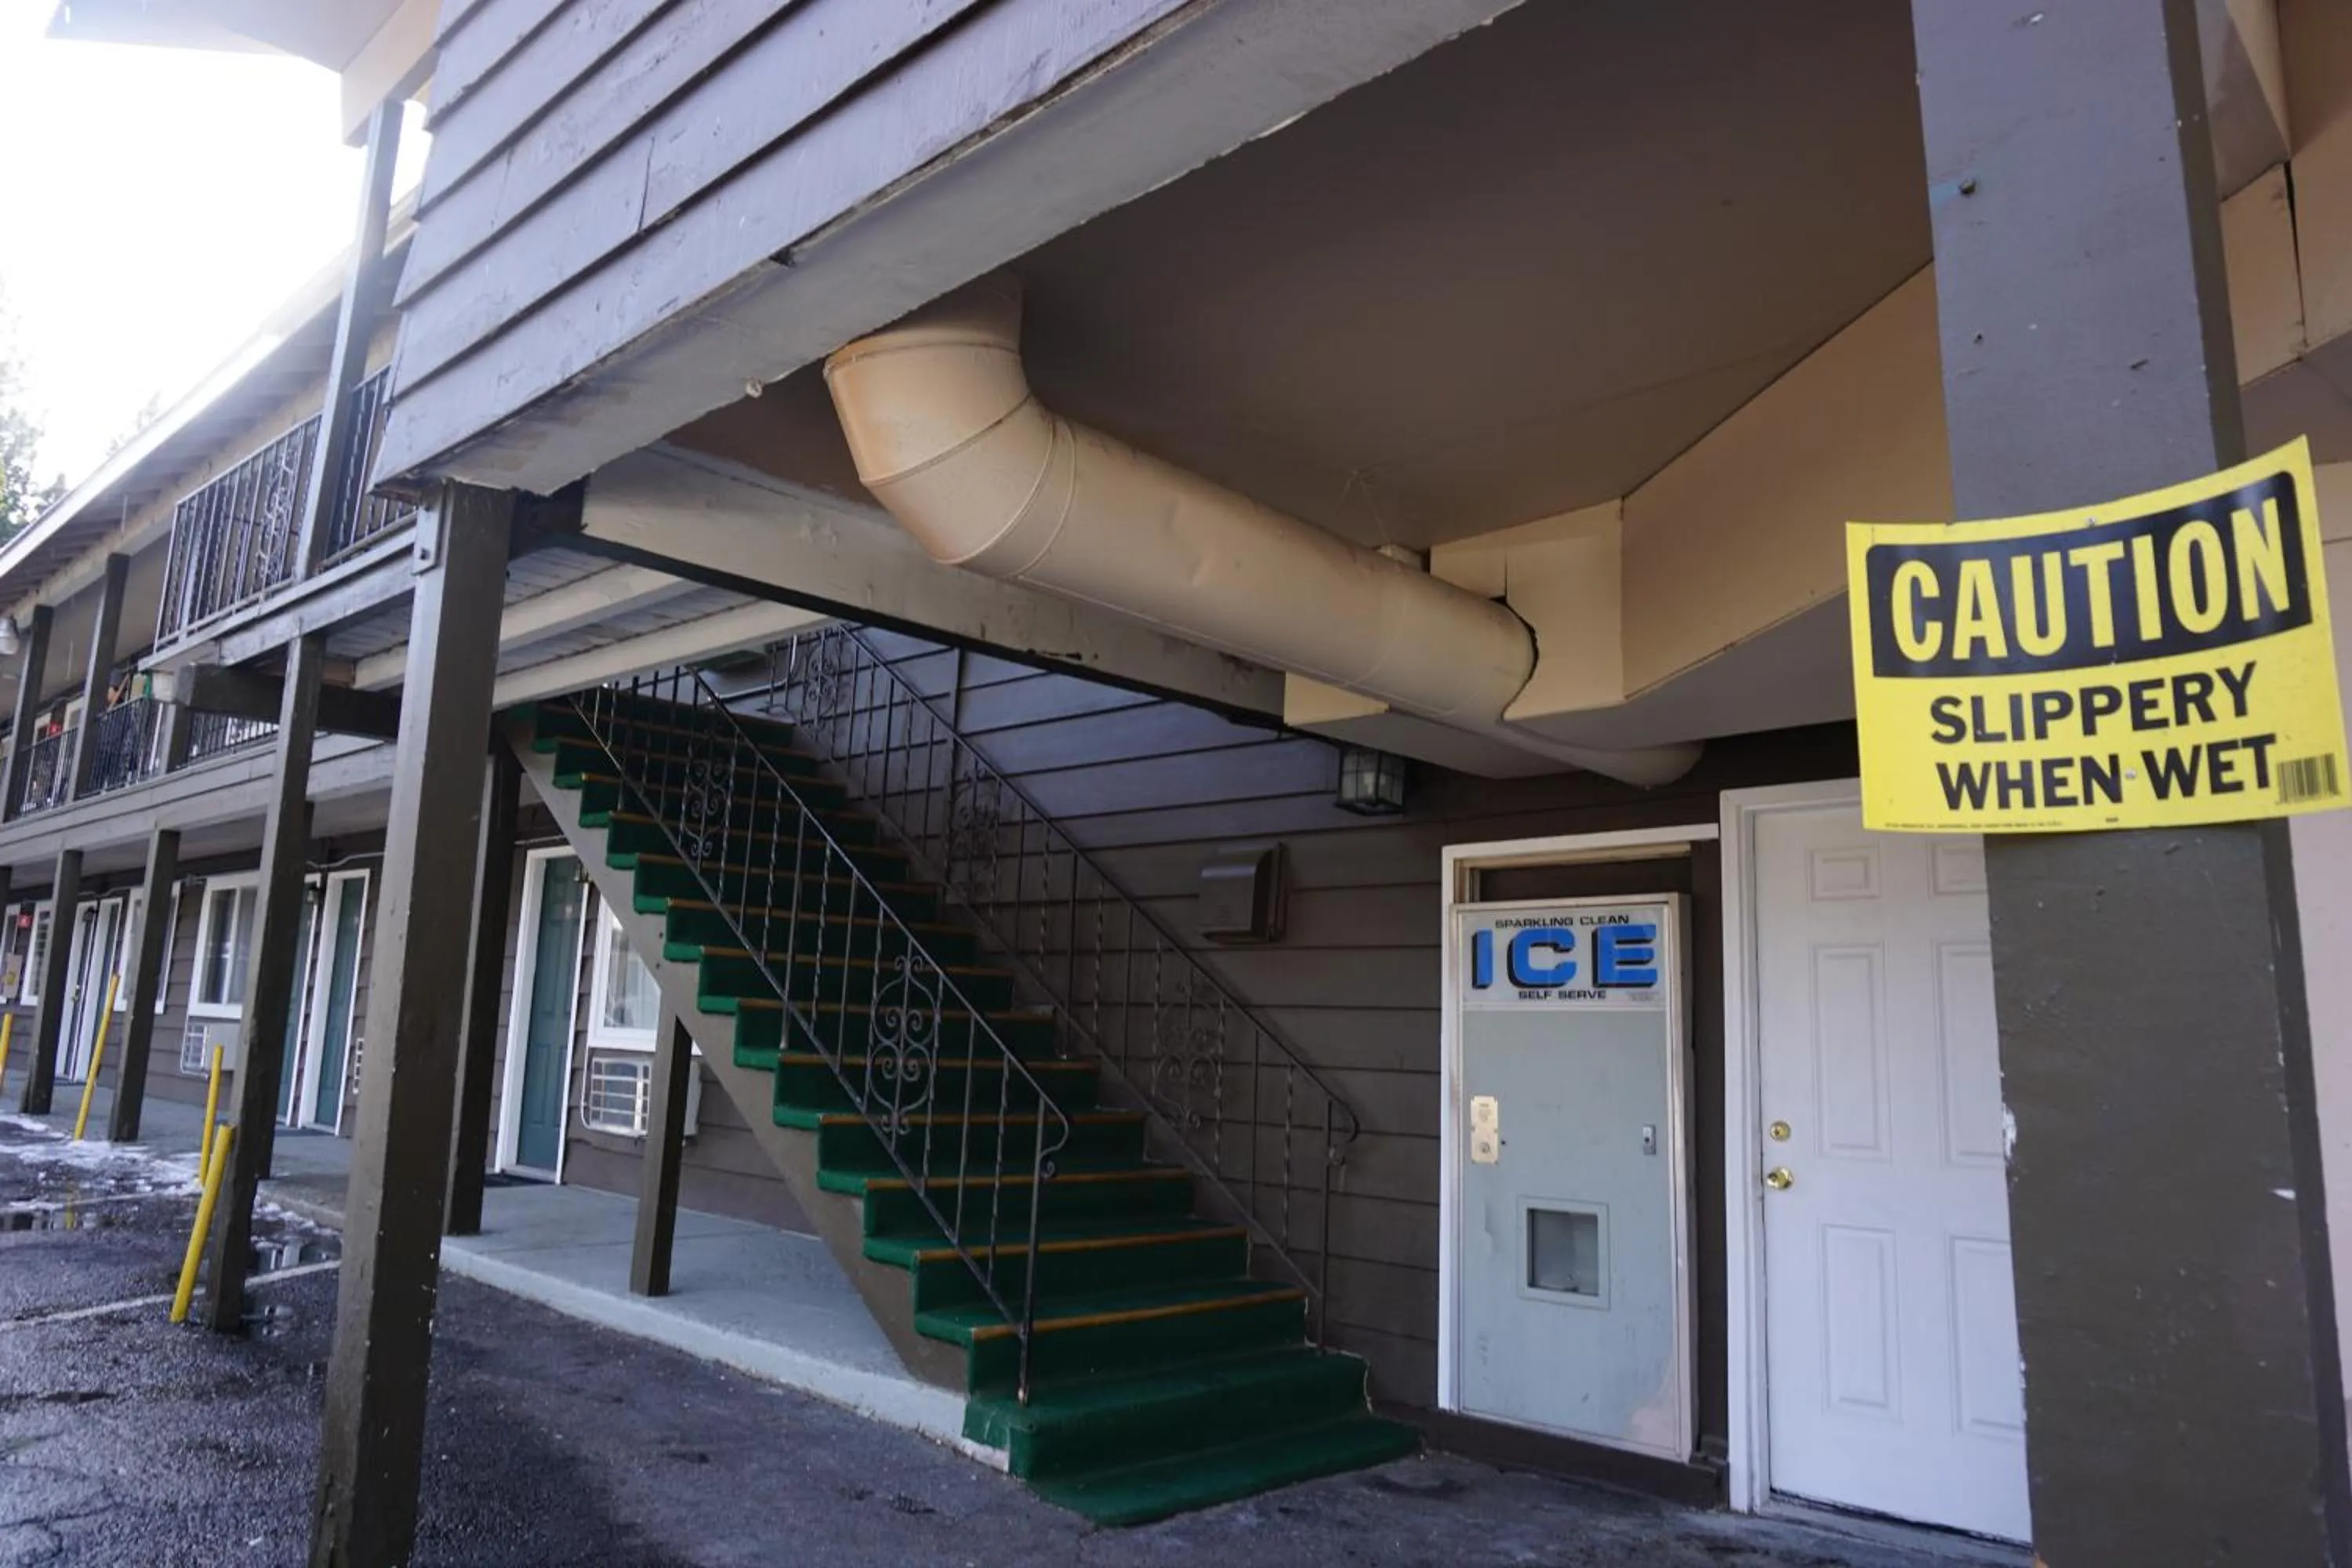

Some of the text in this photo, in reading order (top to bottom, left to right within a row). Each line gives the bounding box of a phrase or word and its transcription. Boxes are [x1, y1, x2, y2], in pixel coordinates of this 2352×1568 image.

[1890, 497, 2291, 662] CAUTION
[1929, 660, 2257, 745] SLIPPERY
[1936, 733, 2278, 811] WHEN WET
[1472, 924, 1658, 989] ICE
[1495, 914, 1629, 928] SPARKLING CLEAN
[1519, 989, 1606, 1000] SELF SERVE
